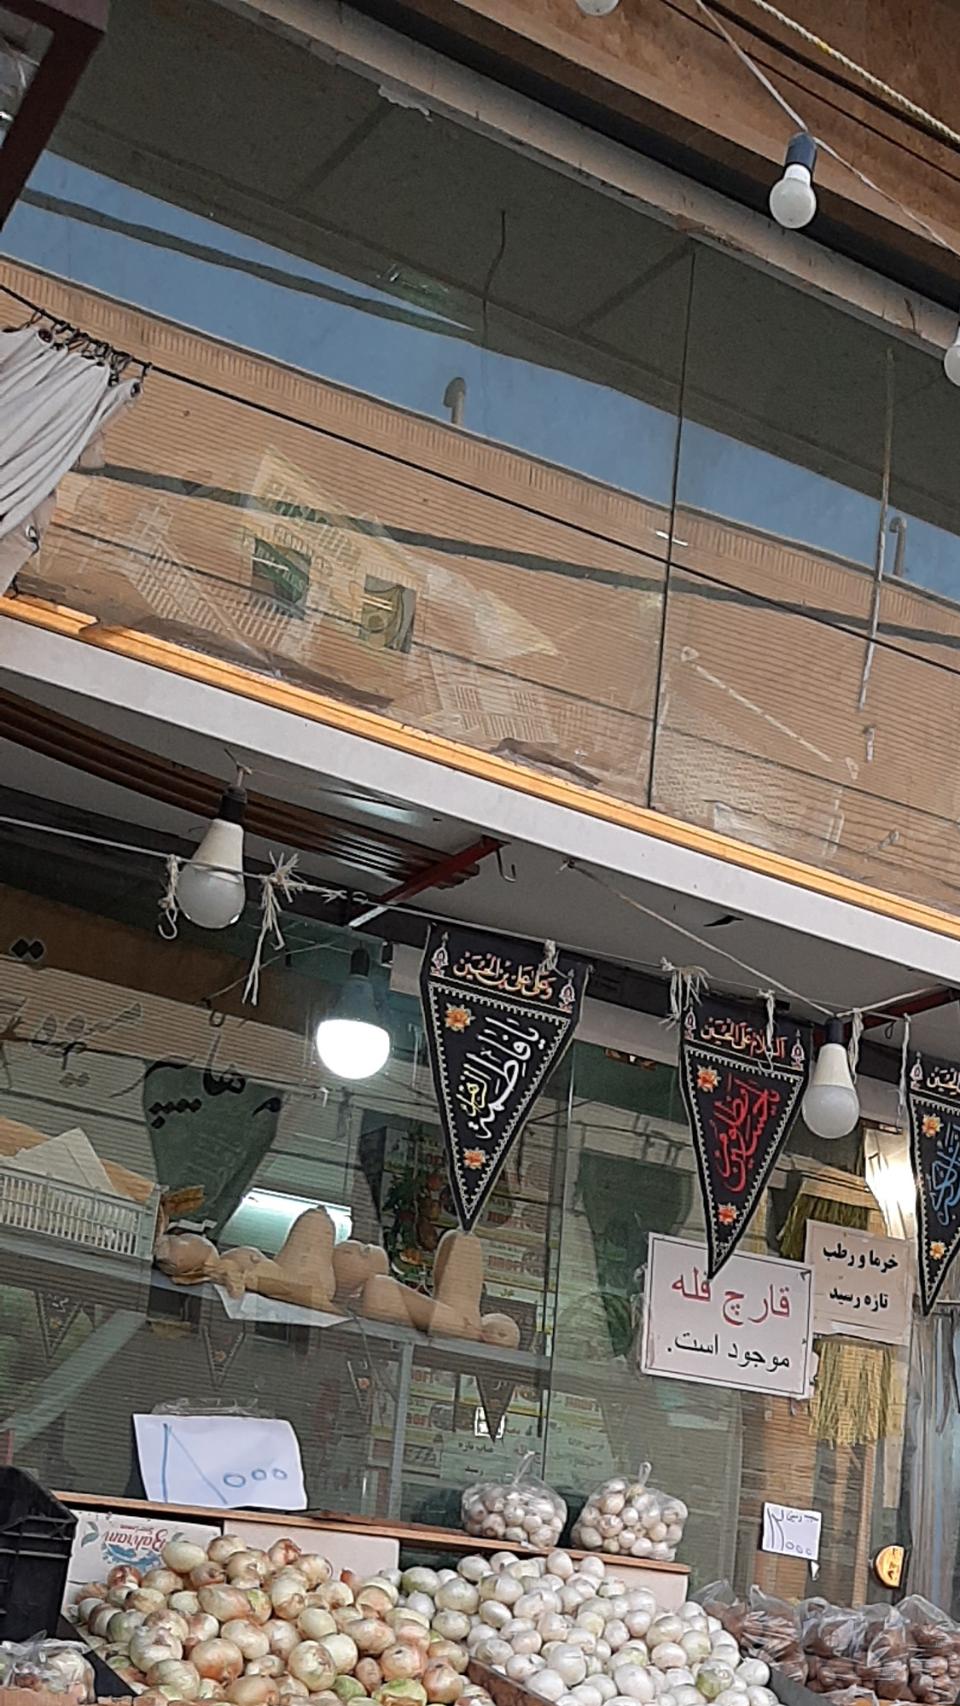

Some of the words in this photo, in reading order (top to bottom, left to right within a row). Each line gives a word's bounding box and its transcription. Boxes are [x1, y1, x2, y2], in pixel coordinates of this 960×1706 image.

[822, 1243, 856, 1267] رطب
[857, 1254, 866, 1269] و
[869, 1249, 899, 1274] خرما
[671, 1265, 714, 1303] فله
[829, 1286, 861, 1308] رسید
[863, 1292, 889, 1312] تازه
[727, 1344, 791, 1374] موجود
